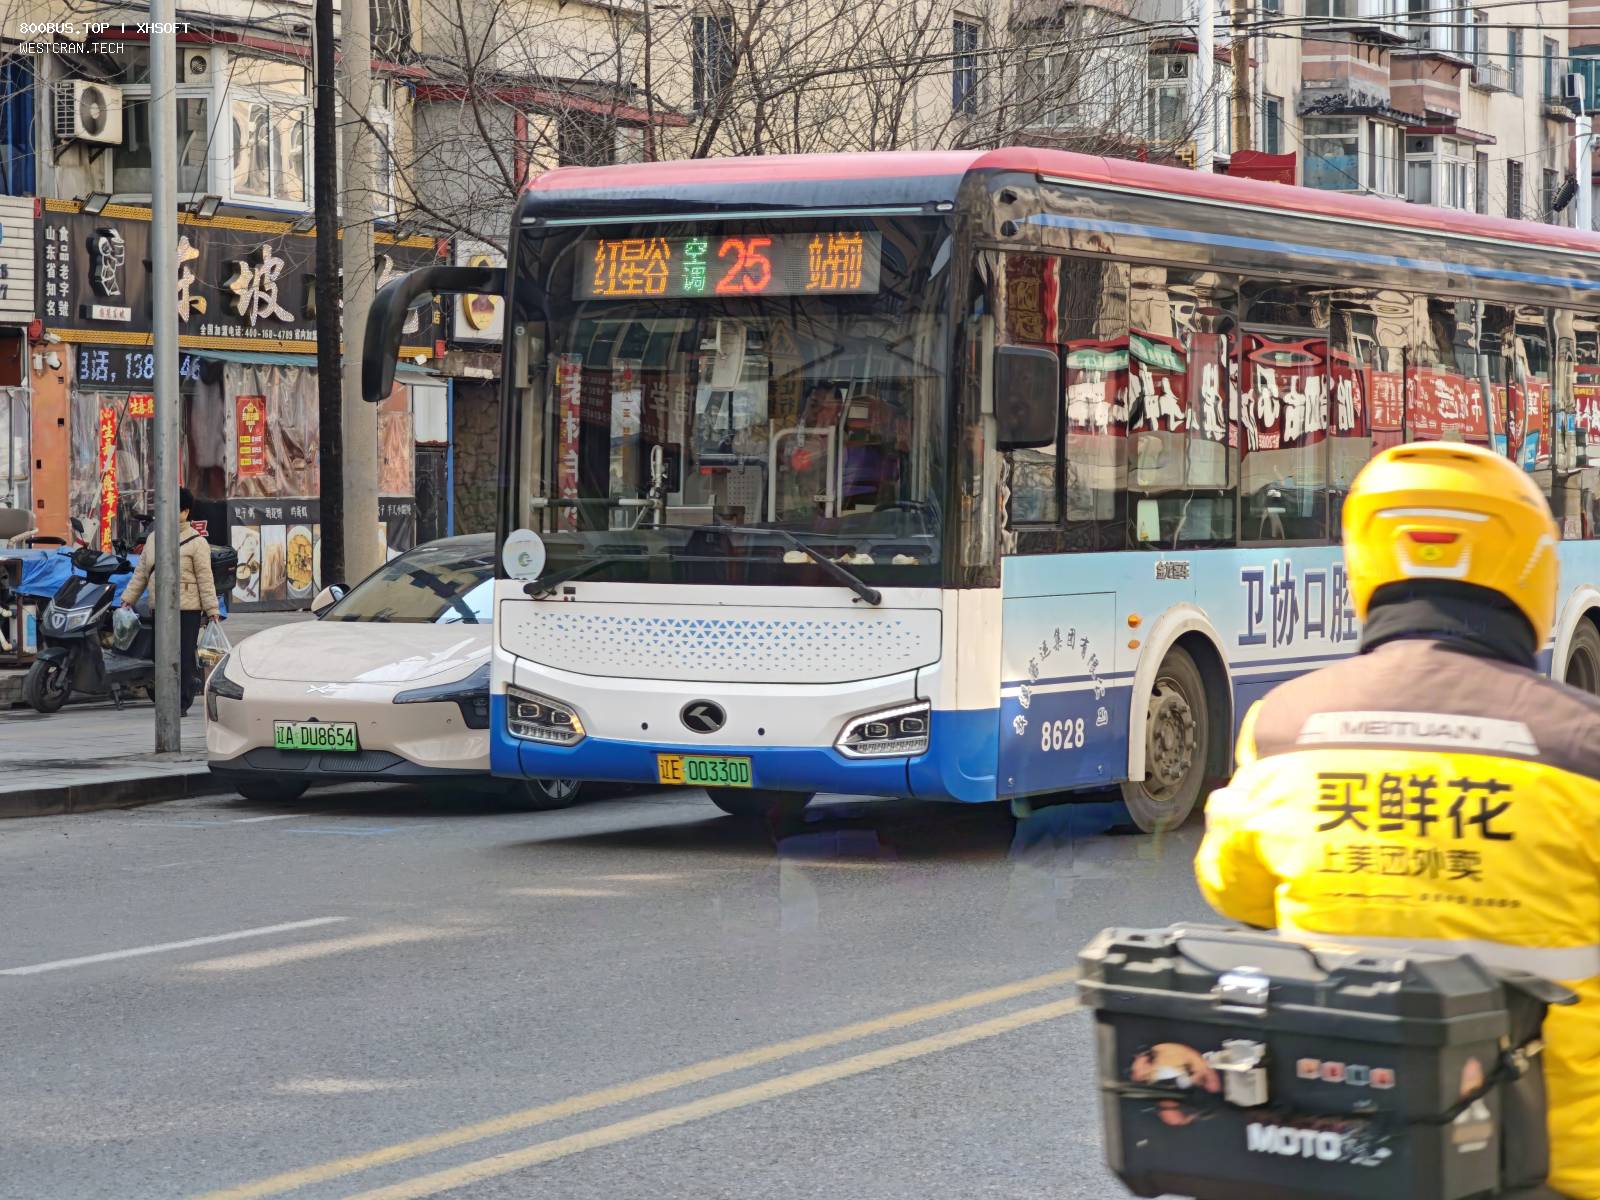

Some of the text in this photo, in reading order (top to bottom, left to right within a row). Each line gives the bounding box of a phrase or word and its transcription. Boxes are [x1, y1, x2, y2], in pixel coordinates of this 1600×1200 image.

[45, 226, 56, 316] 山东省知名
[681, 237, 707, 292] 空调
[716, 238, 771, 294] 25
[805, 231, 863, 290] 站前
[1238, 561, 1358, 649] 卫协口腔
[277, 726, 354, 747] 辽A DU8654
[1041, 717, 1085, 752] 8628
[1341, 720, 1481, 741] MEITUAN
[661, 759, 749, 783] 辽E 00330D
[1316, 772, 1515, 841] 买鲜花
[1317, 844, 1483, 882] 上美团外卖
[1246, 1122, 1342, 1161] MOTO
